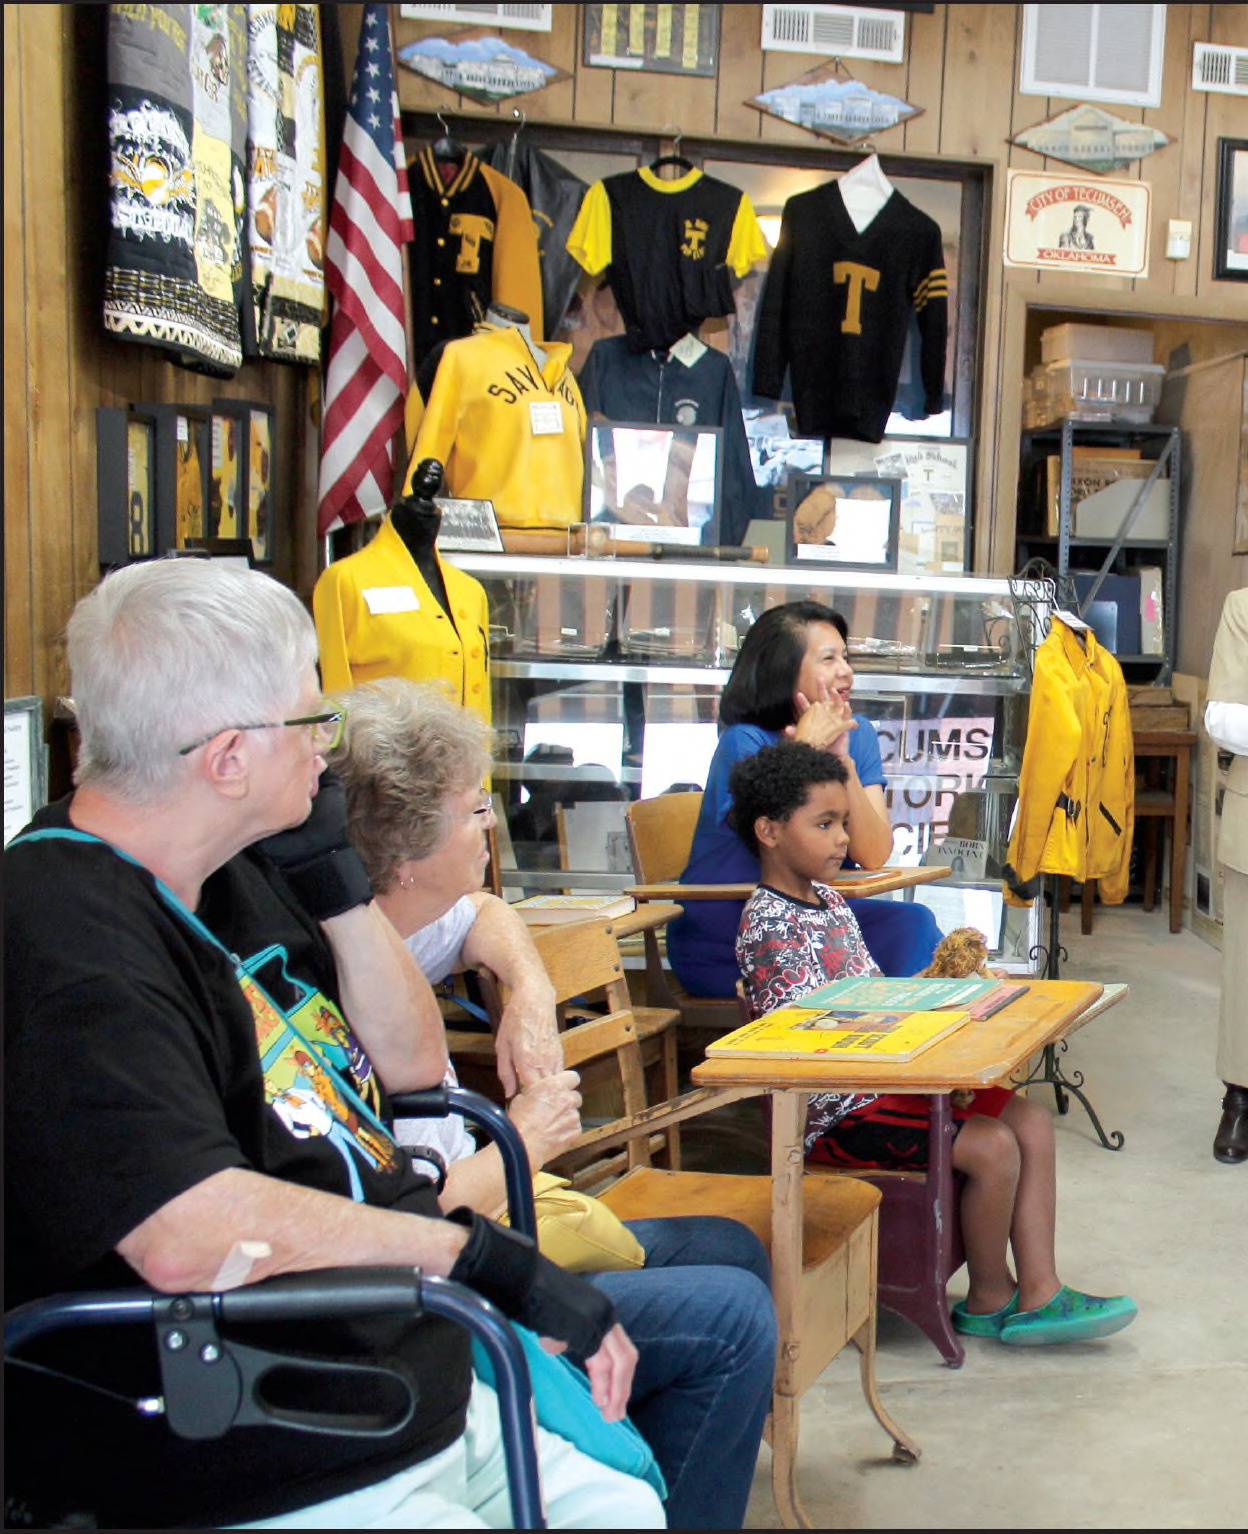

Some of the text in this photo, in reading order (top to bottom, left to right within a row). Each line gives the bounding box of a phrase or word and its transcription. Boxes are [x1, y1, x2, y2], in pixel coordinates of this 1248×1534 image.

[1030, 187, 1131, 217] CITY OF TECUMSEH
[1043, 249, 1111, 262] OKLAHOMA
[833, 260, 881, 335] T
